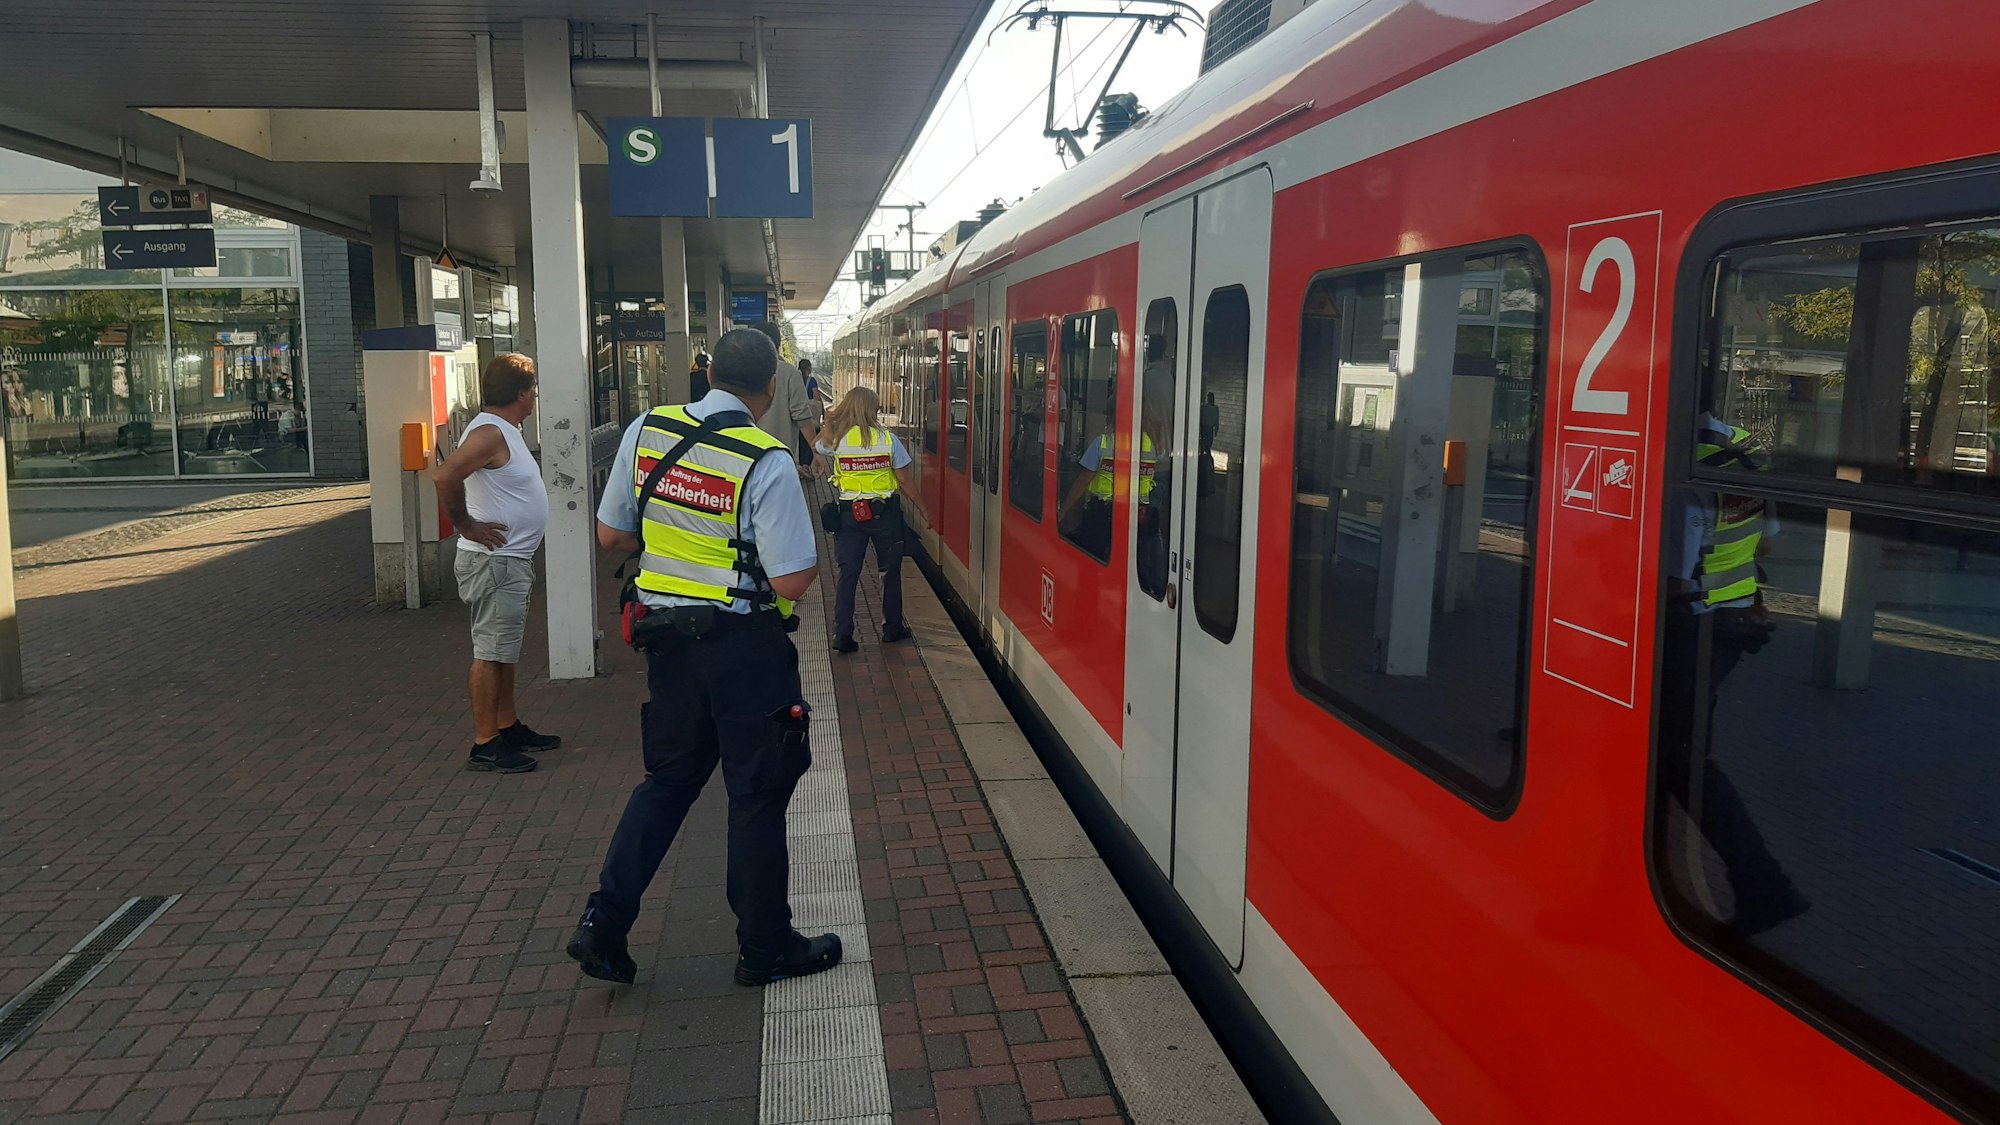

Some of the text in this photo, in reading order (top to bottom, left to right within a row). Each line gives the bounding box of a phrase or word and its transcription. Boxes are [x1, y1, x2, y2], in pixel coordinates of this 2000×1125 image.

[628, 129, 657, 163] S
[771, 124, 800, 193] 1
[152, 196, 167, 204] Bus
[143, 242, 186, 253] Ausgang
[635, 330, 664, 339] Aufzug
[1571, 236, 1636, 415] 2
[1048, 323, 1057, 380] 2
[670, 468, 703, 485] Auftrag der
[840, 460, 890, 471] DB Sicherheit
[655, 477, 732, 511] Sicherheit
[1042, 574, 1054, 623] DB
